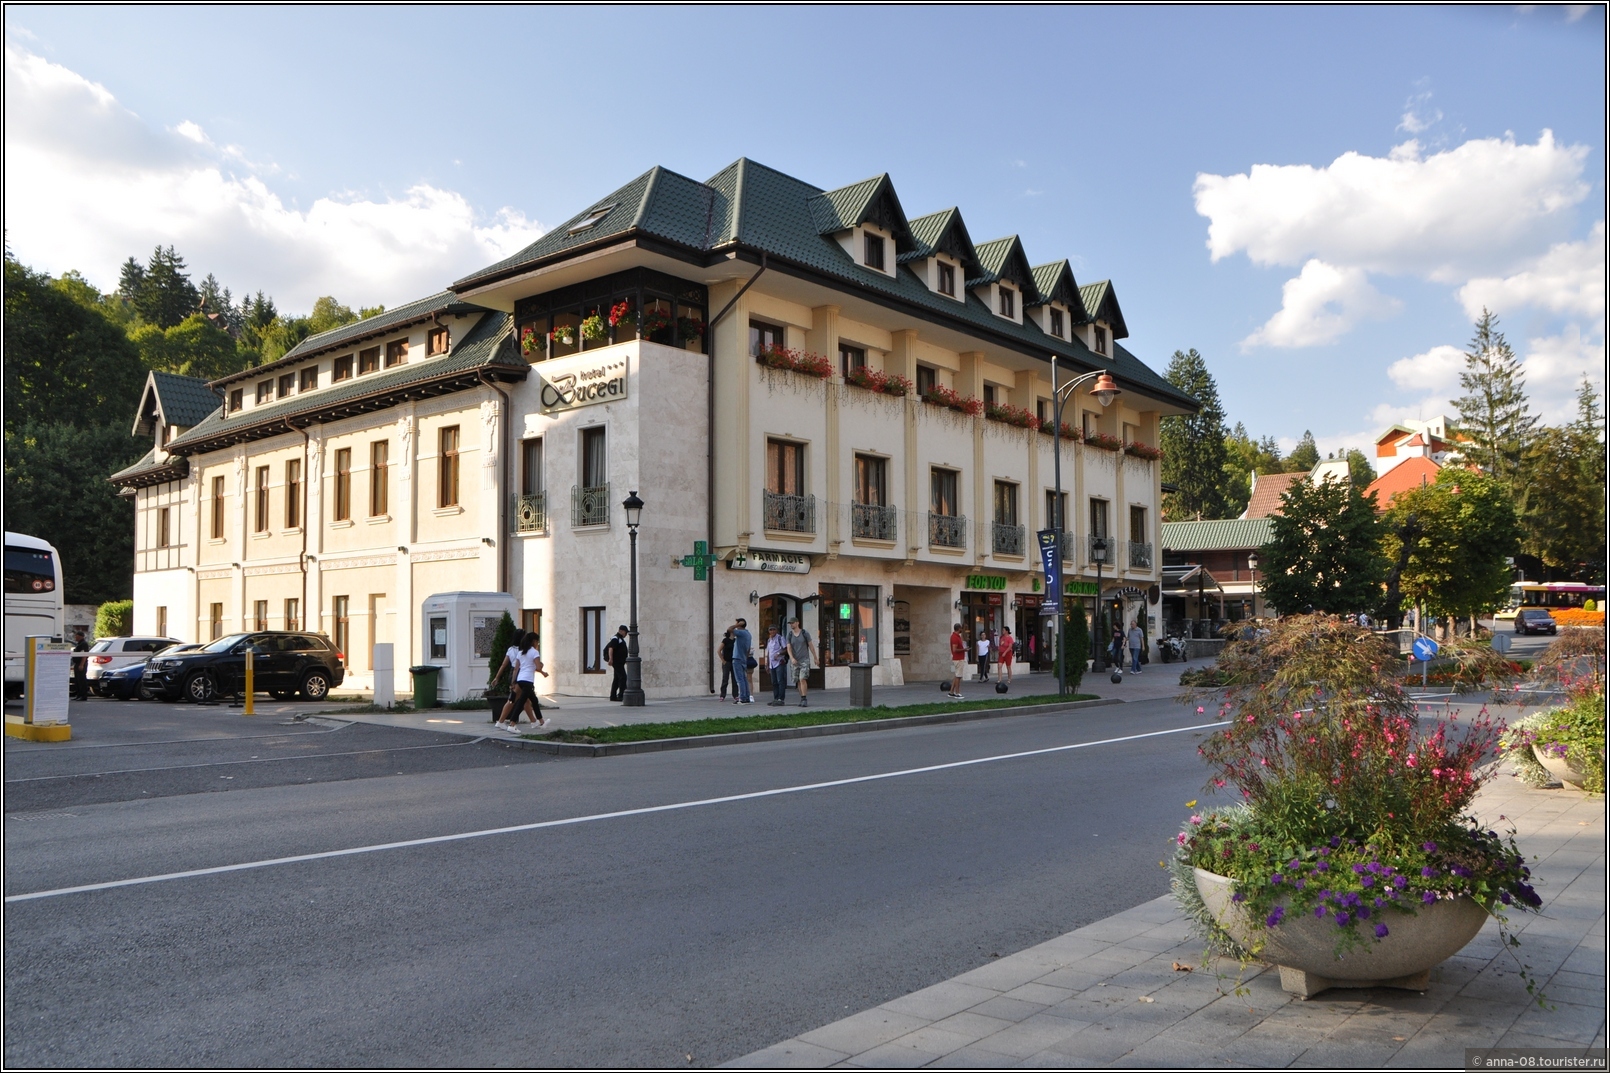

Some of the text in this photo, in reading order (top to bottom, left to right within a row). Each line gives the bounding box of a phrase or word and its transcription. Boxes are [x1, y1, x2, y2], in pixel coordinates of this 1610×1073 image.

[580, 366, 606, 381] hotel
[752, 552, 804, 565] FARMACIE
[966, 575, 987, 589] FOR
[989, 576, 1007, 590] YOU
[1066, 581, 1082, 594] FOR
